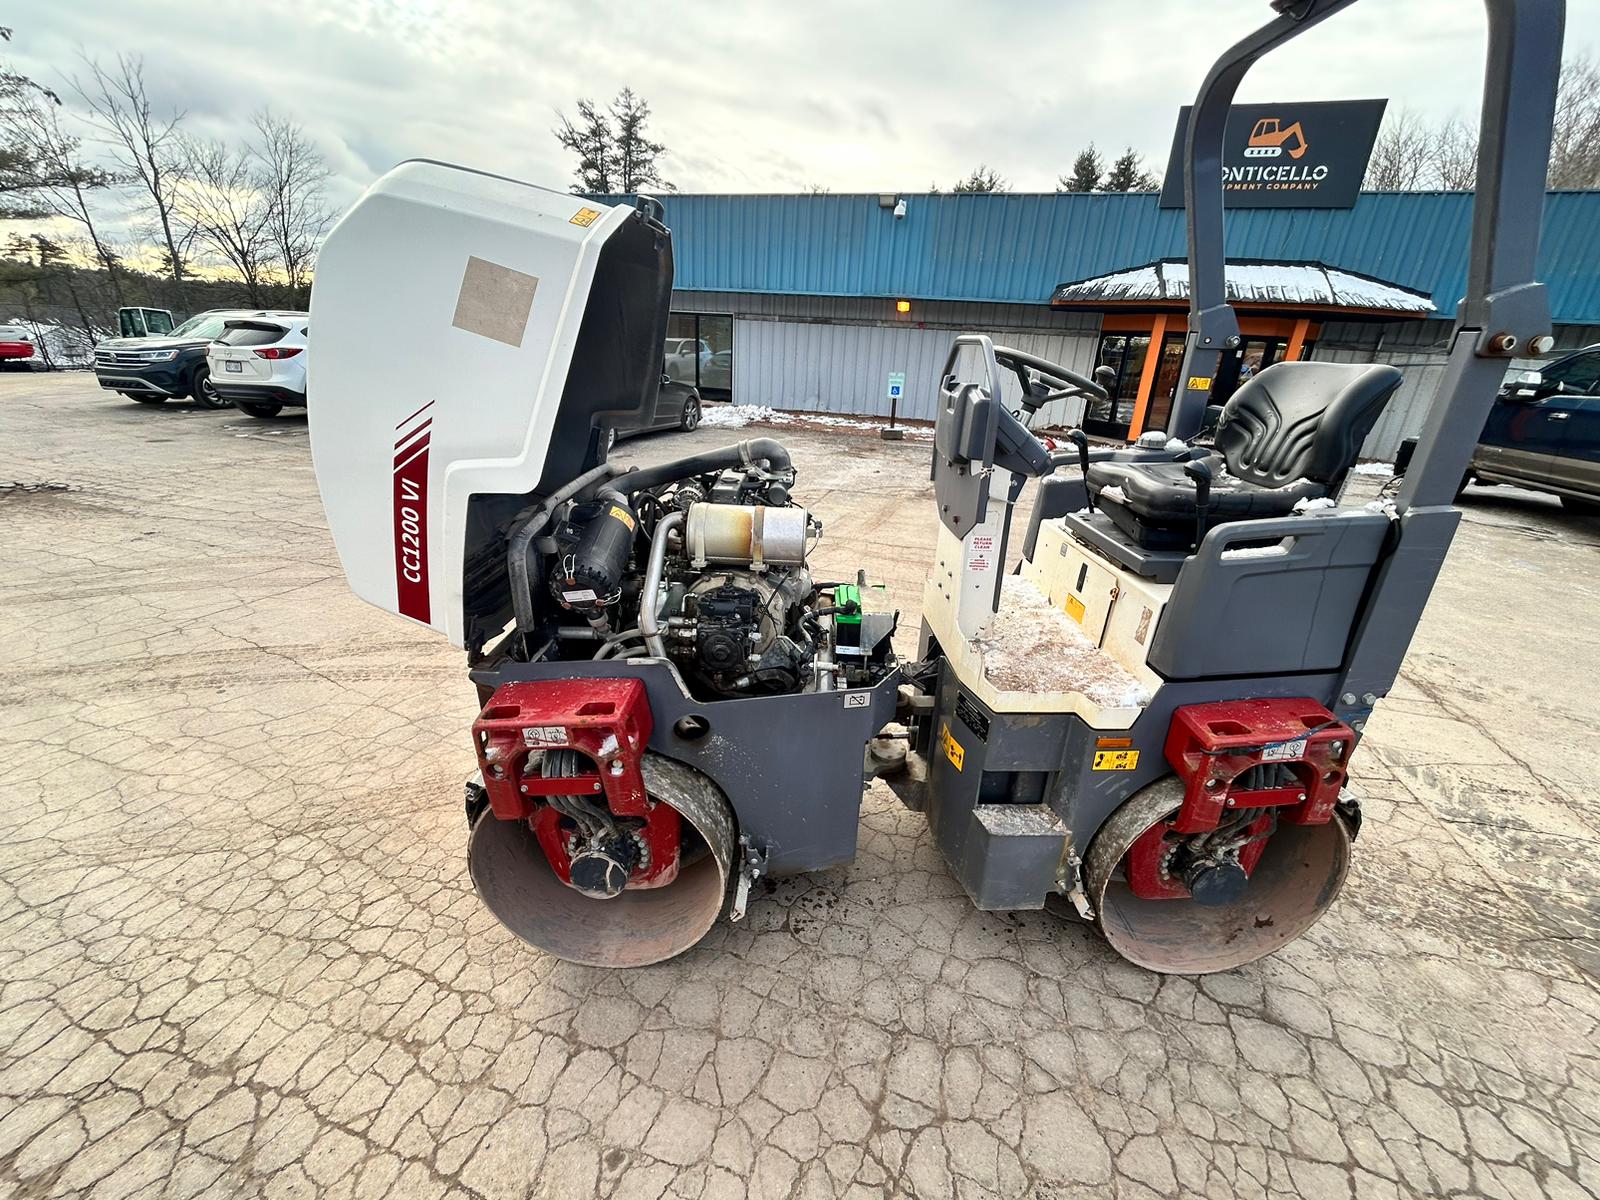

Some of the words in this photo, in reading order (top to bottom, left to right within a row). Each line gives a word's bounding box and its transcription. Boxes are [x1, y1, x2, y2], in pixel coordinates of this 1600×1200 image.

[1222, 165, 1329, 181] ONTICELLO
[401, 477, 420, 501] VI
[401, 506, 421, 583] CC1200
